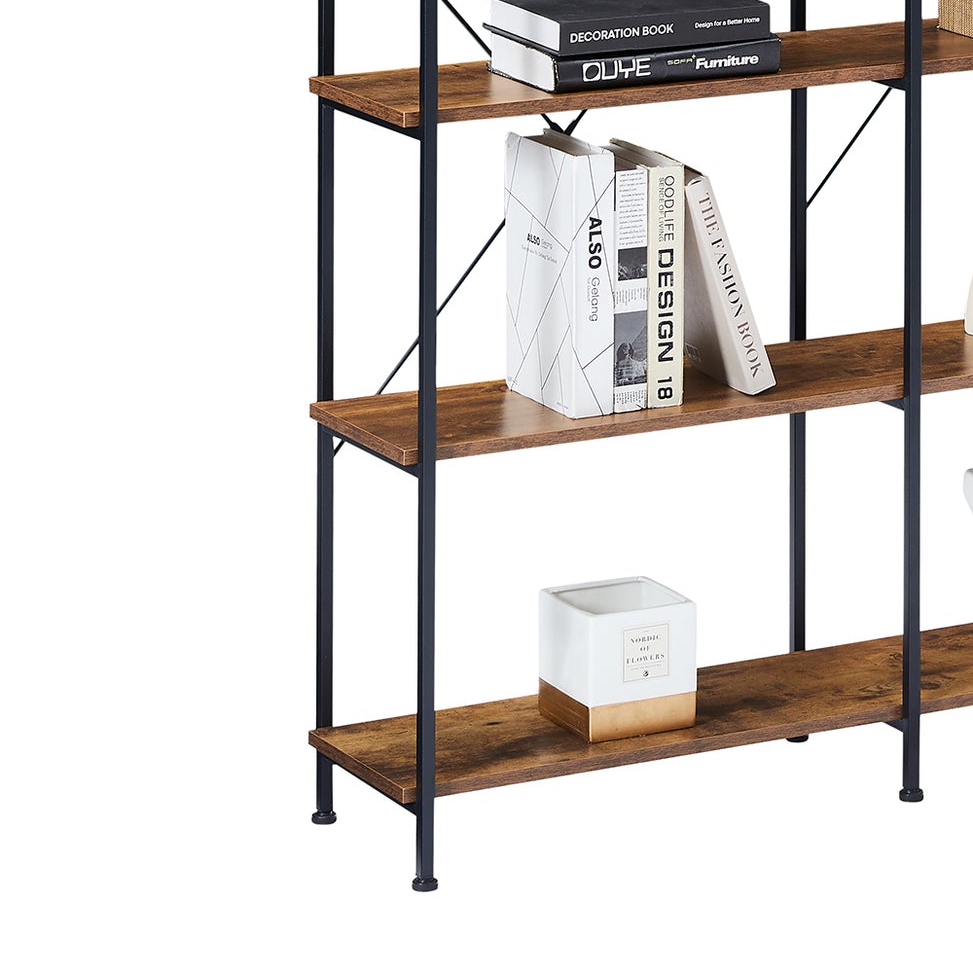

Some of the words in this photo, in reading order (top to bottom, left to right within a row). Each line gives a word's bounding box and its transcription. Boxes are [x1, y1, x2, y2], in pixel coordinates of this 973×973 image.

[694, 20, 713, 29] Design
[727, 18, 743, 26] Better
[744, 16, 760, 24] Home
[570, 27, 640, 44] DECORATION
[642, 24, 674, 36] BOOK
[696, 54, 759, 70] Furniture
[658, 204, 664, 214] OF
[664, 175, 675, 242] OODLIFE
[527, 233, 541, 246] ALSO
[588, 216, 602, 270] ALSO
[698, 192, 720, 238] THE
[712, 238, 746, 319] FASHION
[737, 318, 764, 378] BOOK
[588, 276, 601, 322] Gelang
[658, 248, 674, 363] DESIGN
[658, 377, 673, 400] 18
[630, 634, 661, 644] NORDIC
[626, 654, 665, 664] FLOWERS
